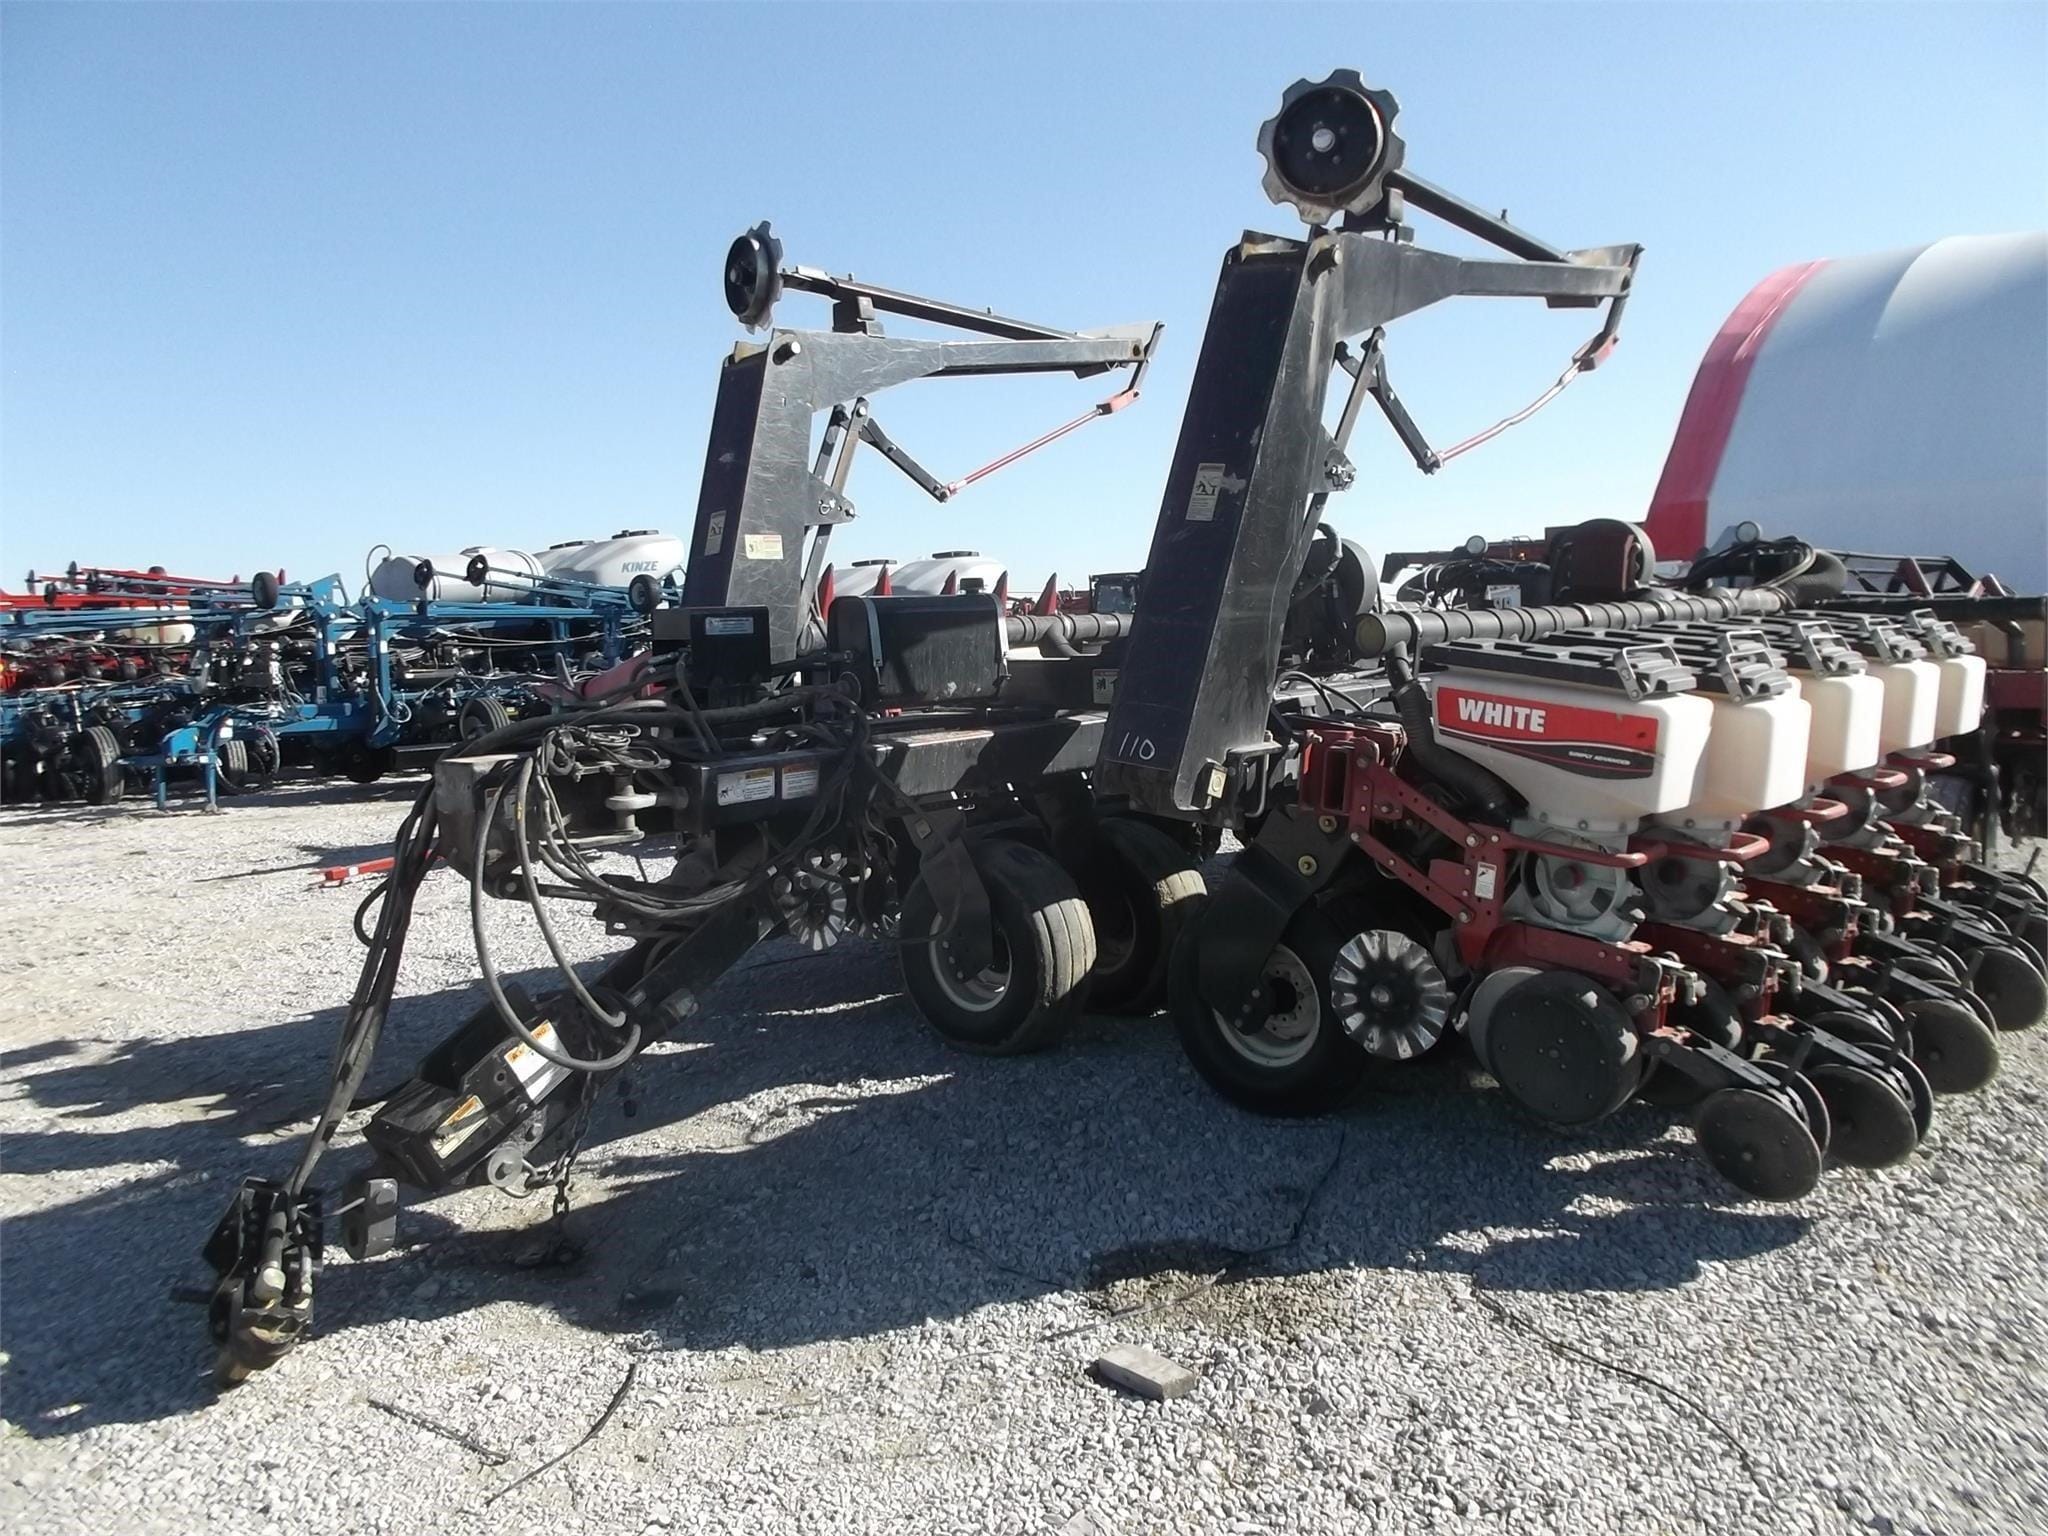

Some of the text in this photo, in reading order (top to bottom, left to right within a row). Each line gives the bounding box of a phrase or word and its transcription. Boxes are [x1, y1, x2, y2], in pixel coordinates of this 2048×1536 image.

[621, 560, 659, 573] KINZE
[1458, 697, 1547, 734] WHITE
[1118, 731, 1156, 760] 110
